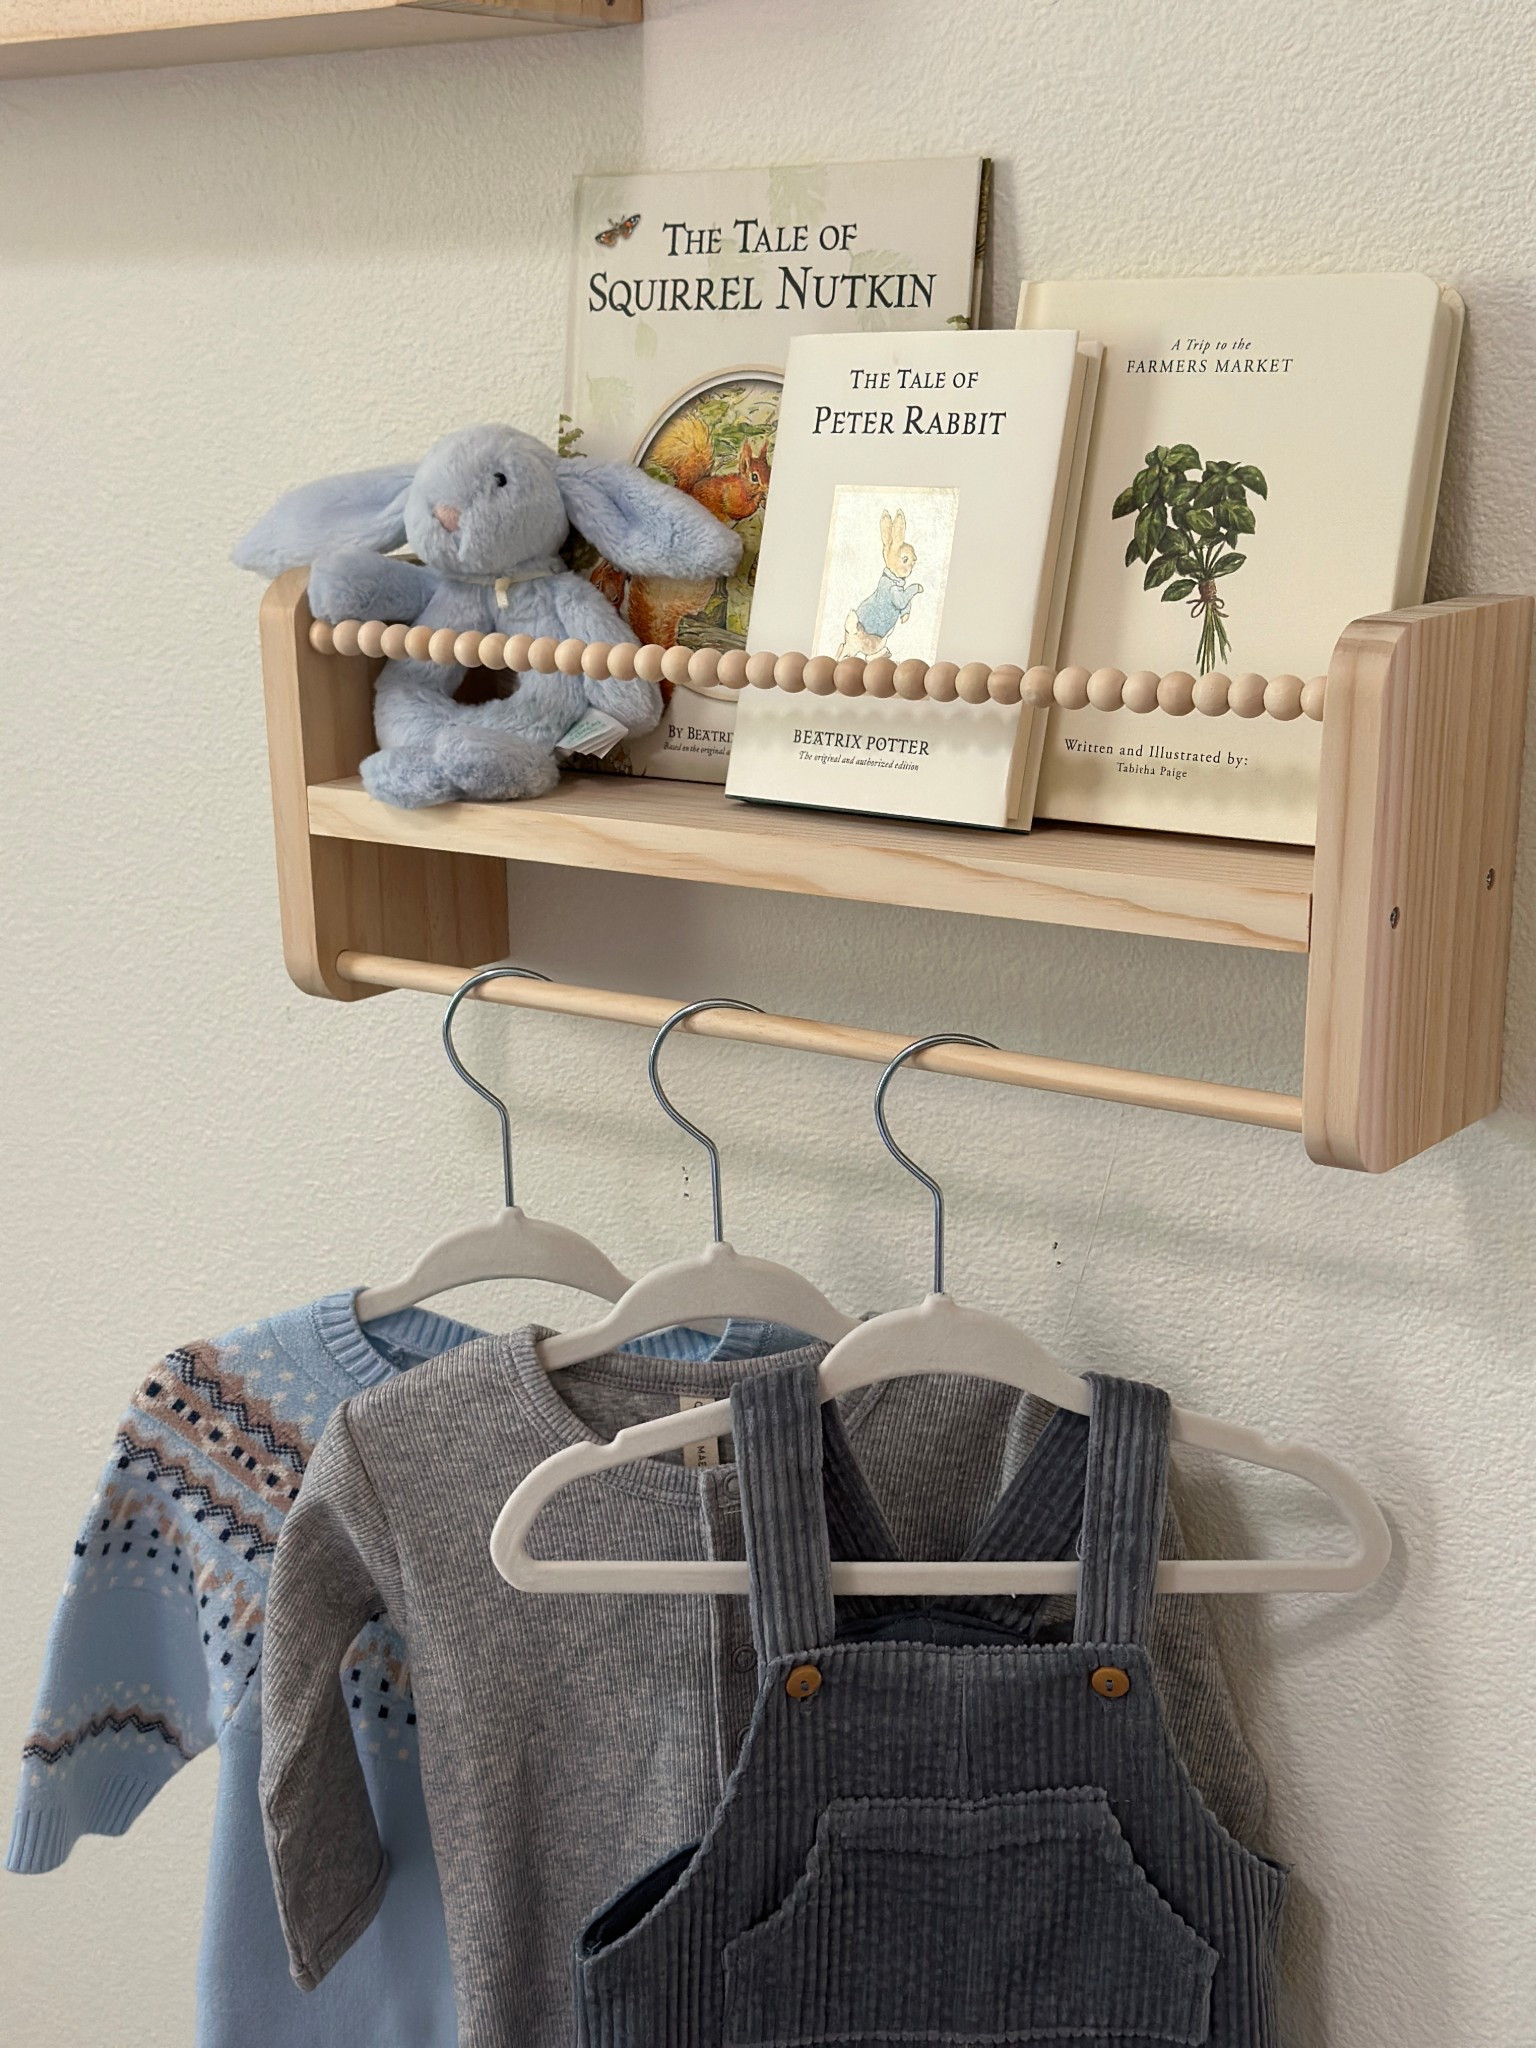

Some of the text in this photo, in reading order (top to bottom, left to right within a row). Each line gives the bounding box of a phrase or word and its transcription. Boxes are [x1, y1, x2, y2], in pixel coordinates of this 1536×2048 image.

[662, 217, 859, 257] THE TALE OF
[588, 266, 938, 318] SQUIRREL NUTKIN
[1170, 337, 1252, 354] A Trip to the
[1126, 357, 1294, 374] FARMERS MARKET
[850, 368, 979, 389] THE TALE OF
[812, 405, 1008, 435] PETER RABBIT
[687, 726, 734, 743] BEATRI
[793, 729, 930, 756] BEATRIX POTTER
[663, 741, 682, 751] Based
[690, 744, 700, 753] the
[700, 746, 726, 757] original
[1064, 738, 1249, 769] Written and Illustrated by:
[799, 750, 919, 771] The original and authorized edition
[1116, 762, 1188, 781] Tabitha Paige
